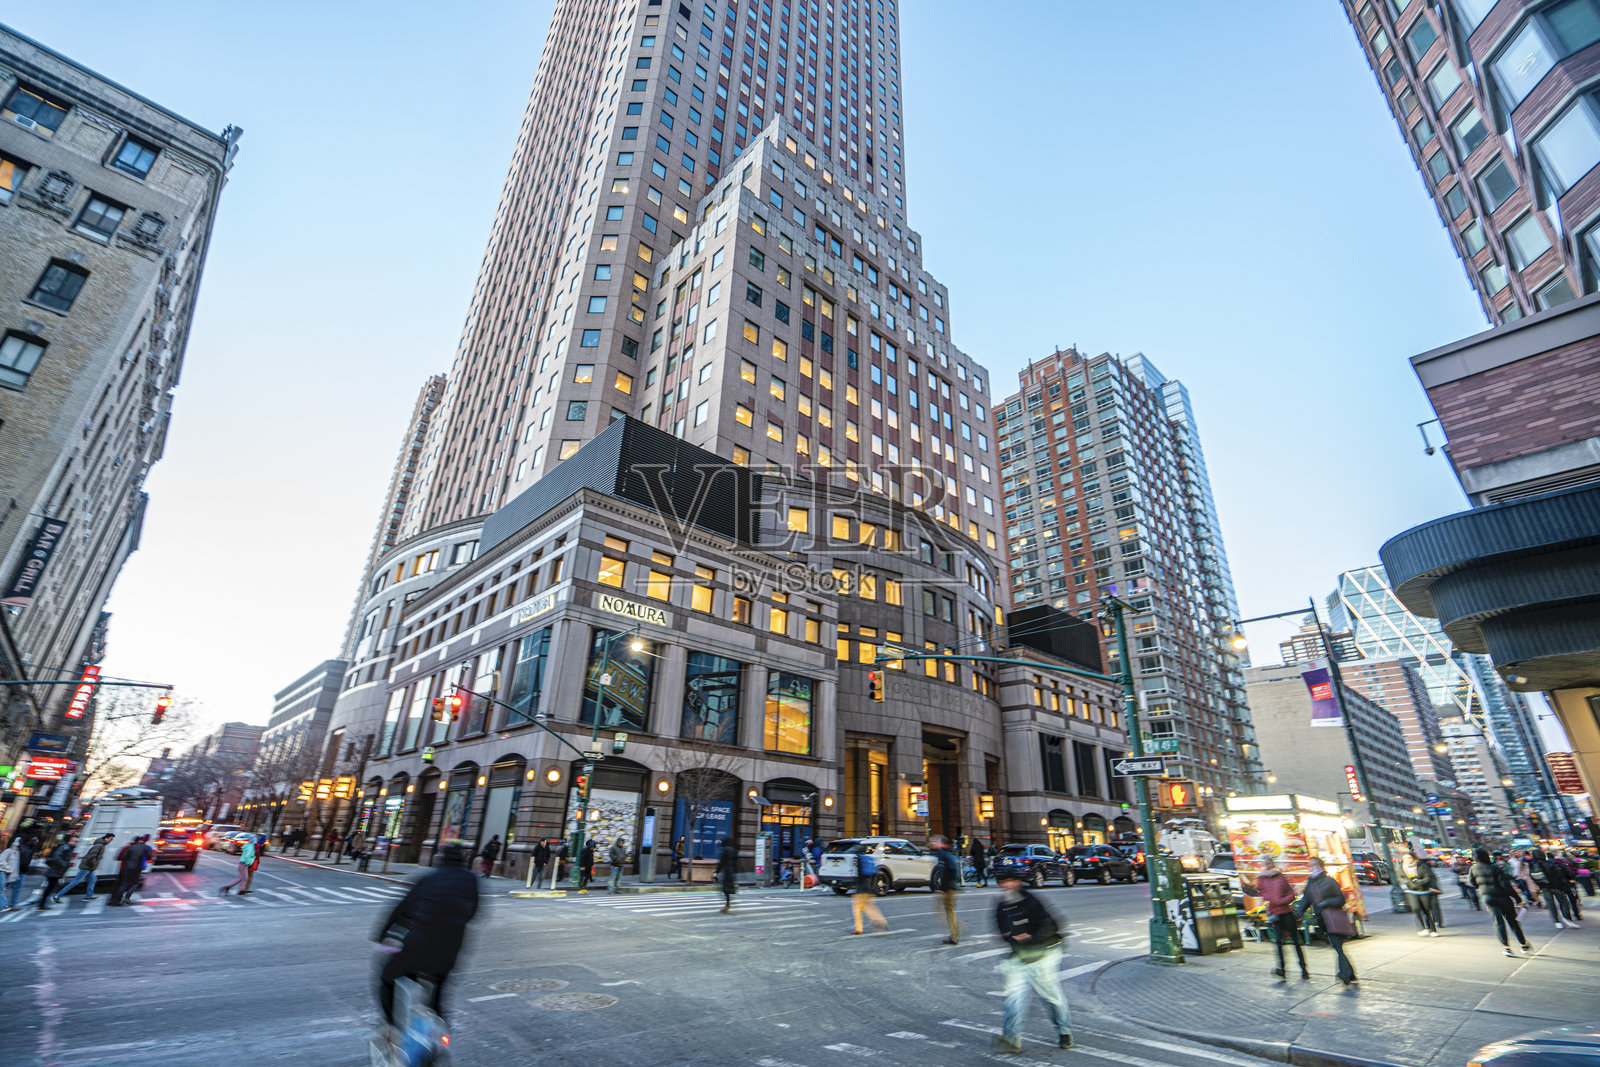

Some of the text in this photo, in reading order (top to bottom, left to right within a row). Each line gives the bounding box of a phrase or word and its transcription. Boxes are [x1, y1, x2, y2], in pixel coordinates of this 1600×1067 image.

[14, 523, 62, 592] BAR GRILL
[601, 594, 667, 625] NOMURA
